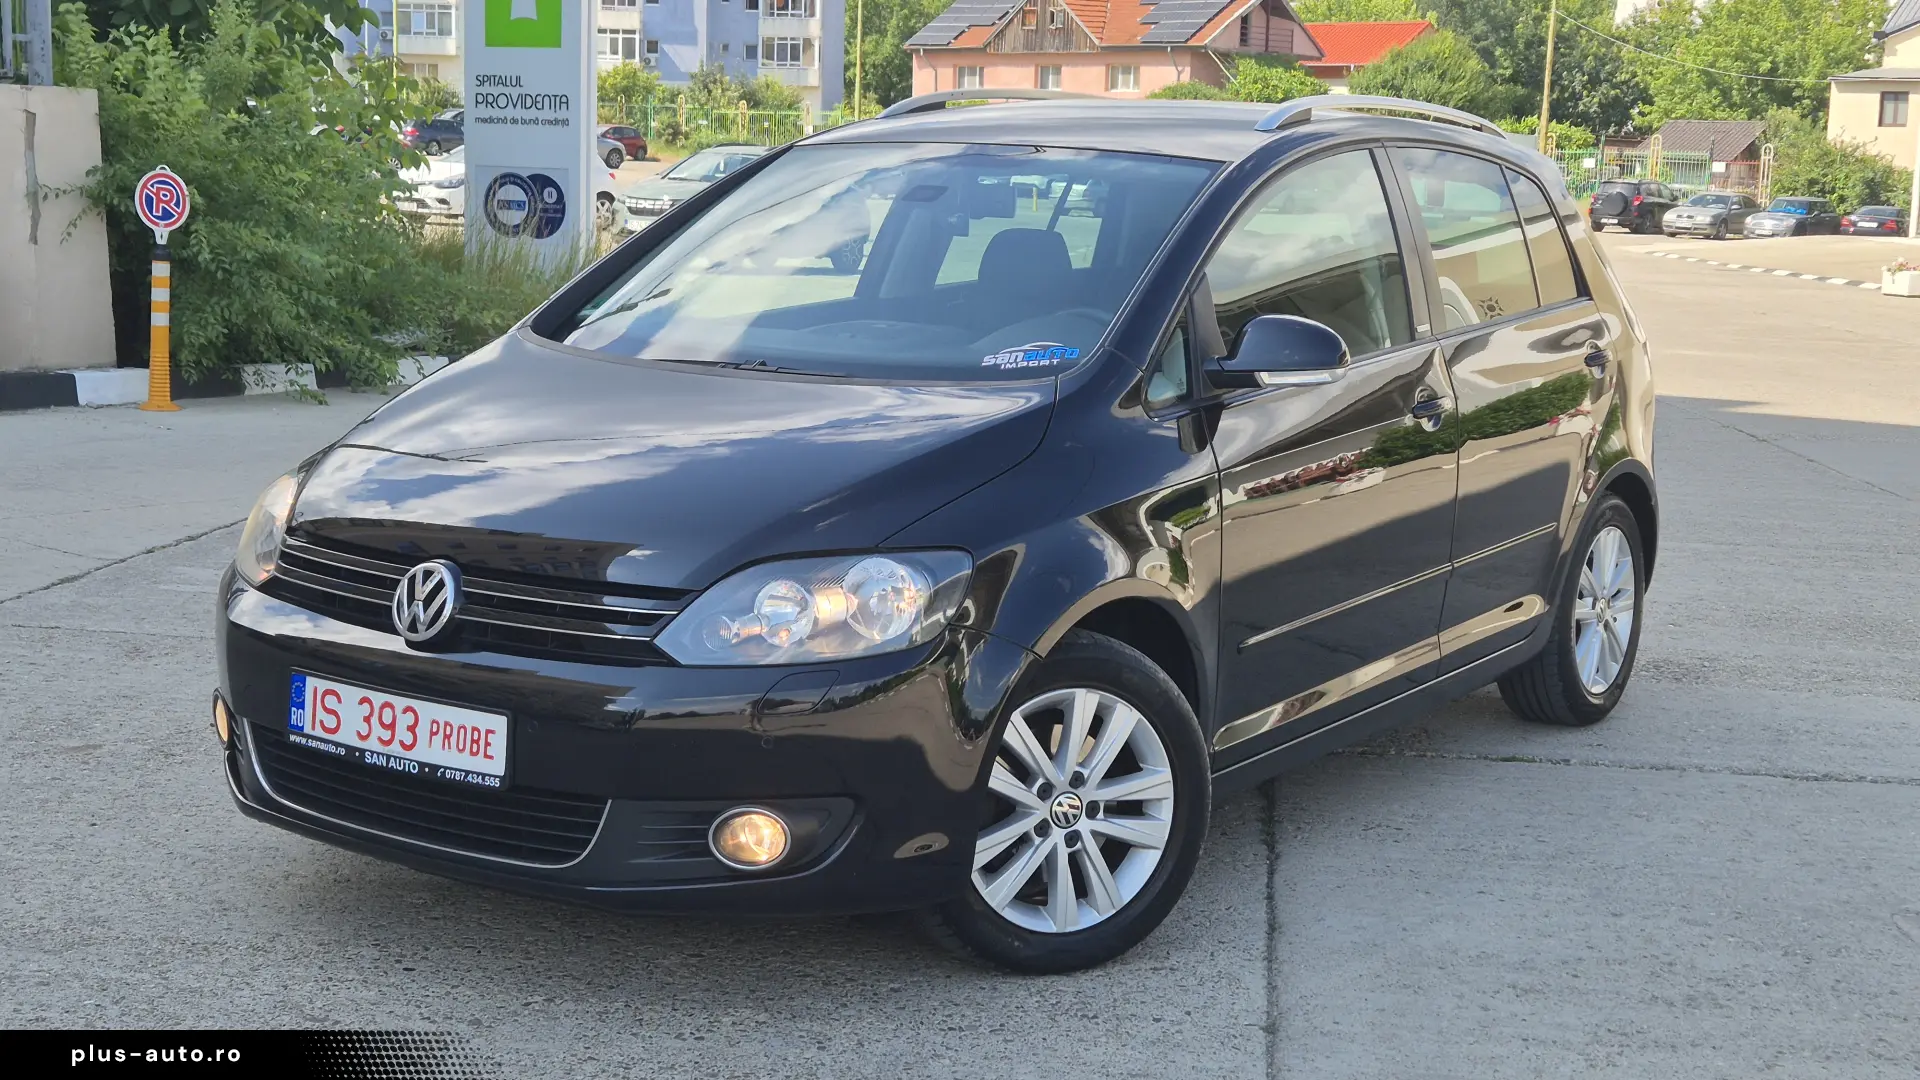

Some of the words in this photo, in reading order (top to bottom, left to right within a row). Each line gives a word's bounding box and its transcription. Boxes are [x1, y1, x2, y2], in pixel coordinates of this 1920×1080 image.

[475, 75, 523, 87] SPITALUL
[475, 116, 508, 125] medicină
[510, 116, 519, 125] de
[521, 117, 539, 126] bună
[1001, 359, 1060, 369] IMPORT
[291, 707, 304, 727] RO
[311, 686, 342, 735] IS
[356, 696, 420, 751] 393
[428, 719, 496, 760] PROBE
[289, 733, 346, 755] www.sanauto.ro
[364, 751, 387, 767] SAN
[388, 757, 418, 774] AUTO
[445, 769, 500, 787] 0787.434.555
